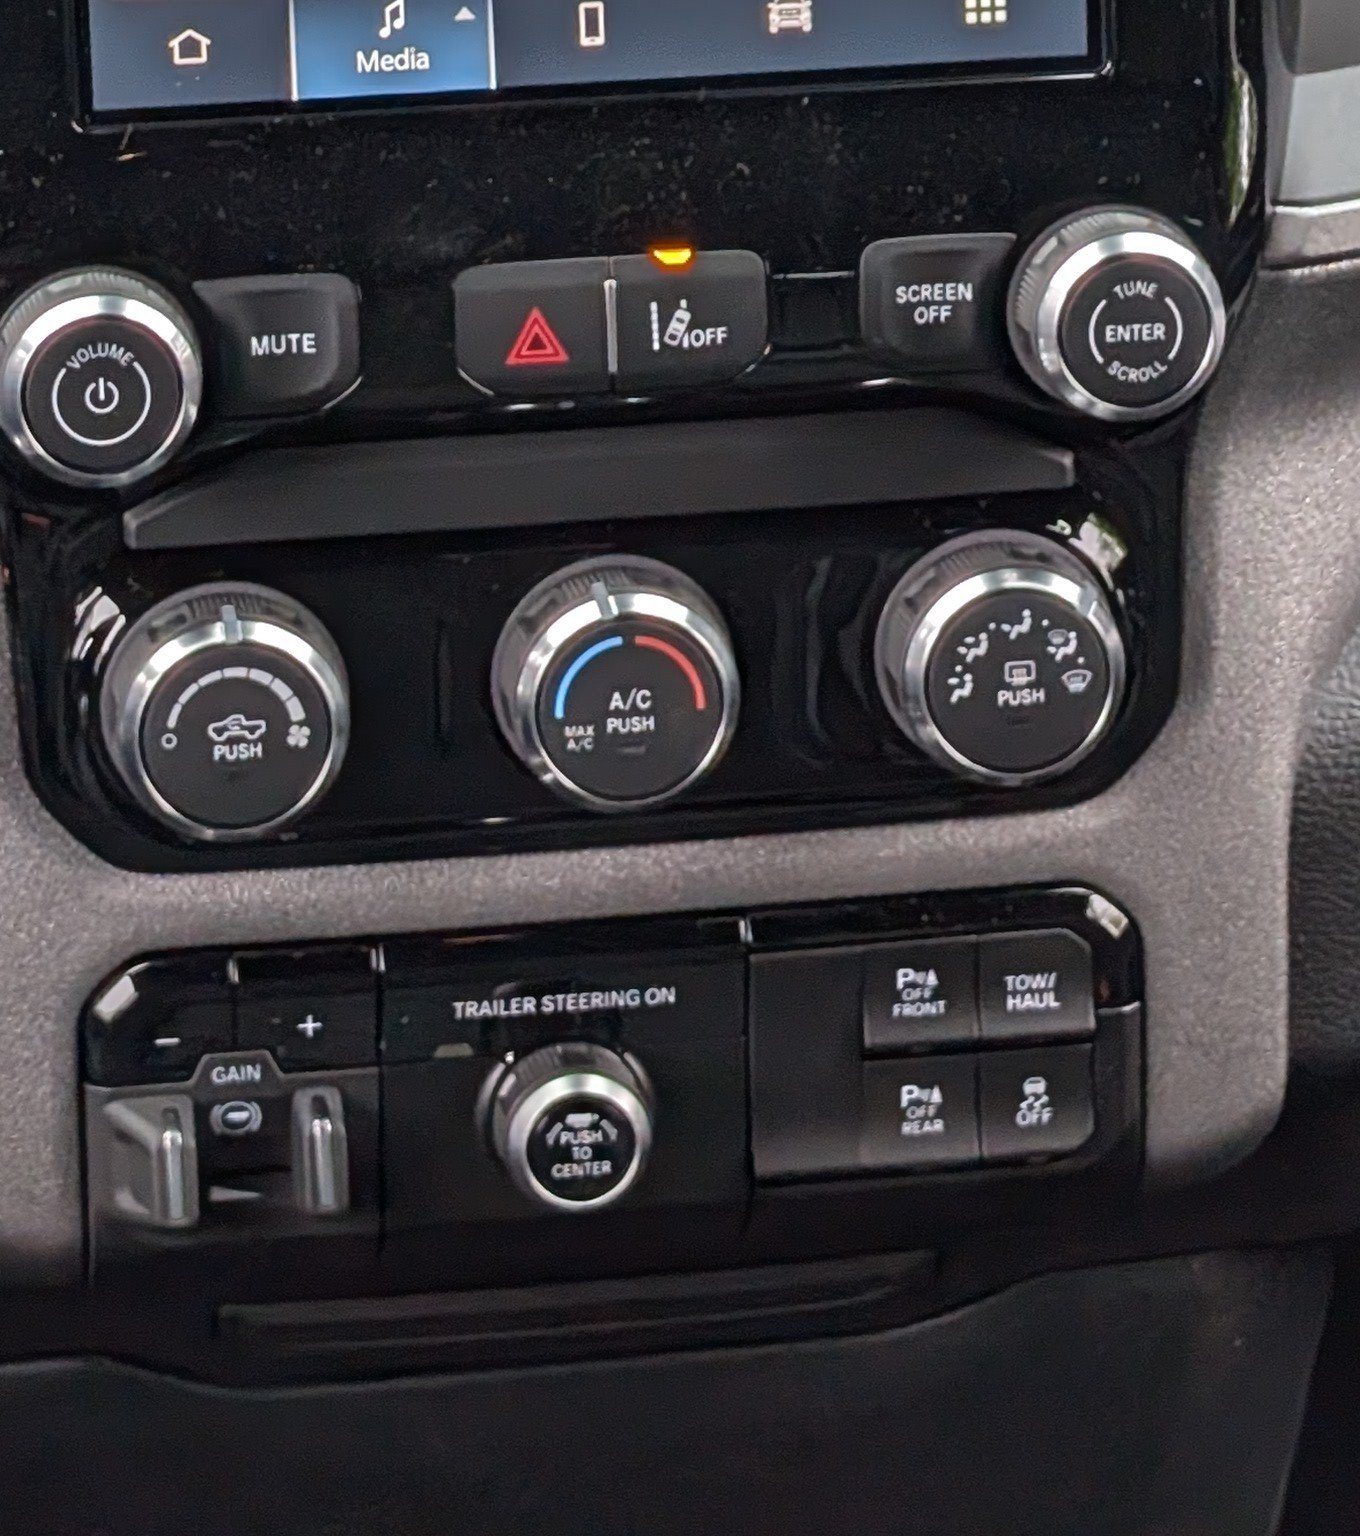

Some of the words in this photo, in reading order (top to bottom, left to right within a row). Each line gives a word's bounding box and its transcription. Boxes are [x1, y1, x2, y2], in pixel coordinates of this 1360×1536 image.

[355, 48, 430, 74] Media
[895, 282, 974, 305] SCREEN
[1112, 280, 1159, 300] TUNE
[913, 304, 952, 325] OFF
[689, 326, 727, 347] OFF
[1105, 321, 1166, 344] ENTER
[250, 332, 318, 357] MUTE
[65, 343, 135, 368] VOLUME
[1107, 359, 1168, 383] SCROLL
[608, 689, 652, 711] A/C
[997, 688, 1045, 708] PUSH
[564, 724, 596, 738] MAX
[606, 714, 656, 735] PUSH
[213, 741, 263, 762] PUSH
[566, 737, 595, 752] A/C
[452, 996, 537, 1019] TRAILER
[540, 989, 642, 1013] STEERING
[644, 986, 676, 1007] ON
[901, 986, 934, 1001] OFF
[1006, 991, 1061, 1012] HAUL
[891, 999, 947, 1018] FRONT
[211, 1064, 262, 1083] GAIN
[905, 1105, 937, 1120] OFF
[1015, 1107, 1054, 1128] OFF
[560, 1128, 603, 1146] PUSH
[900, 1118, 945, 1136] REAR
[571, 1145, 593, 1161] TO
[551, 1160, 613, 1180] CENTER
